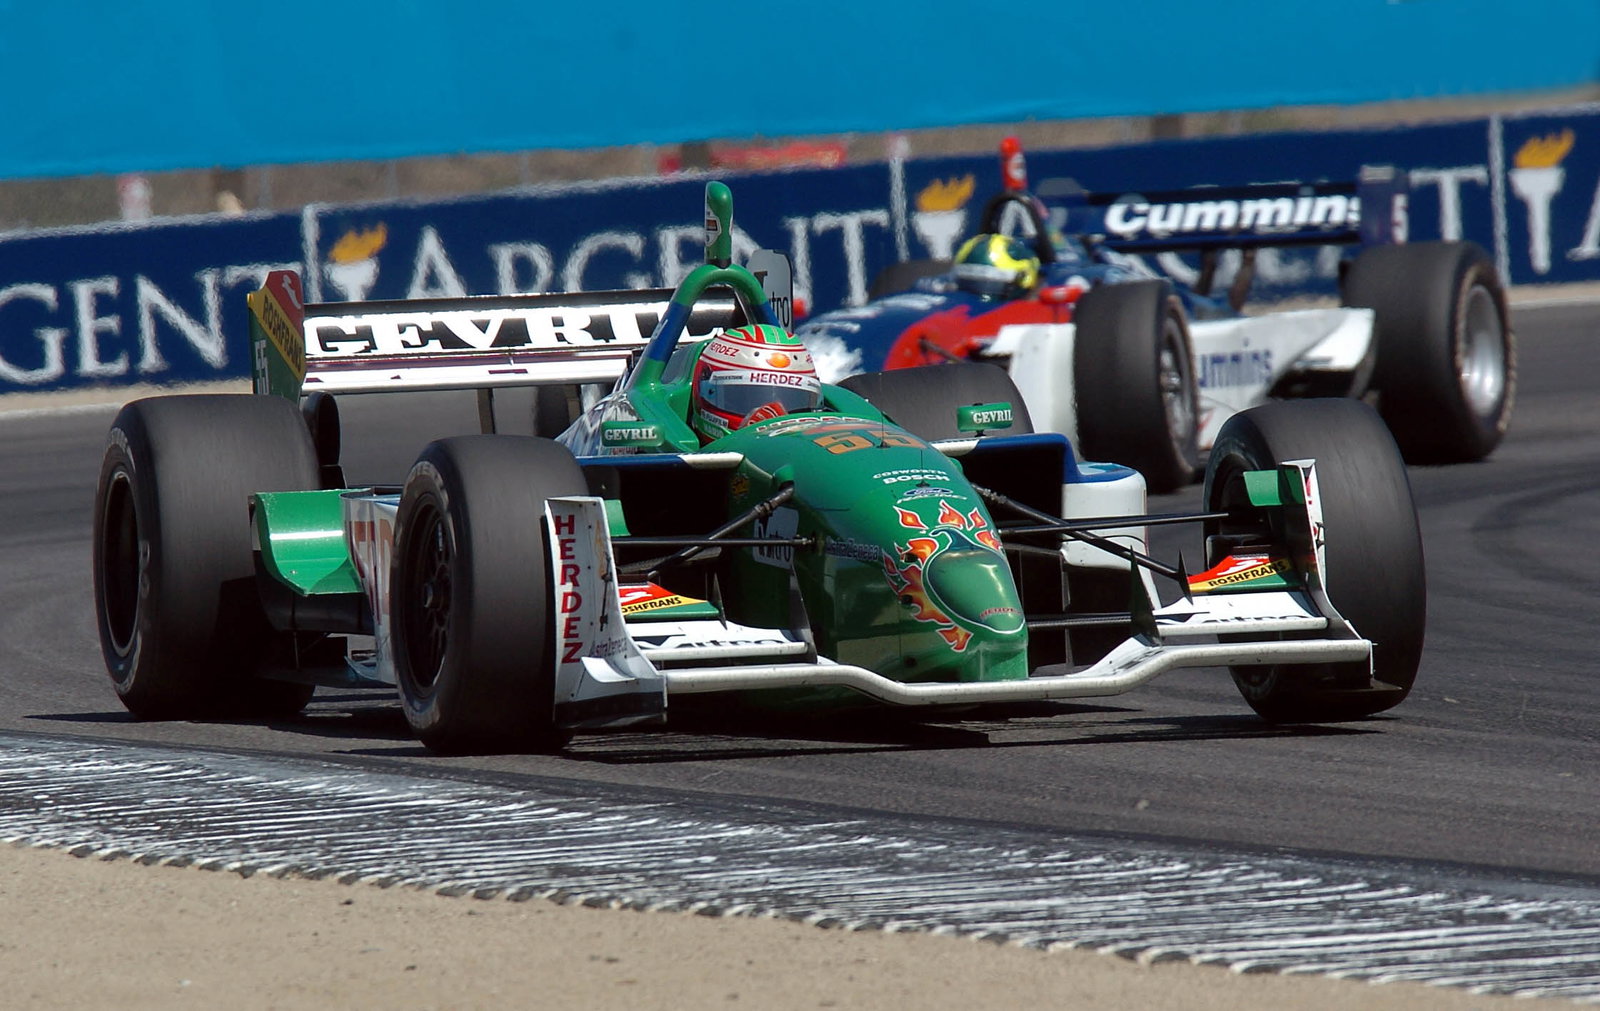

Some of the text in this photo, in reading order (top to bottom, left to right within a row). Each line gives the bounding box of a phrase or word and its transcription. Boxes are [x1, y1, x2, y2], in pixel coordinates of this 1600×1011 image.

[303, 303, 725, 356] GEVRI
[1198, 337, 1272, 389] ummins
[750, 372, 803, 386] HERDEZ
[972, 409, 1014, 424] GEVRIL
[604, 425, 657, 441] GEVRIL
[882, 474, 950, 485] BOSCH
[1208, 558, 1289, 588] ROSHFRANS
[555, 514, 582, 664] HERDEZ
[621, 596, 682, 614] OSHFRANS
